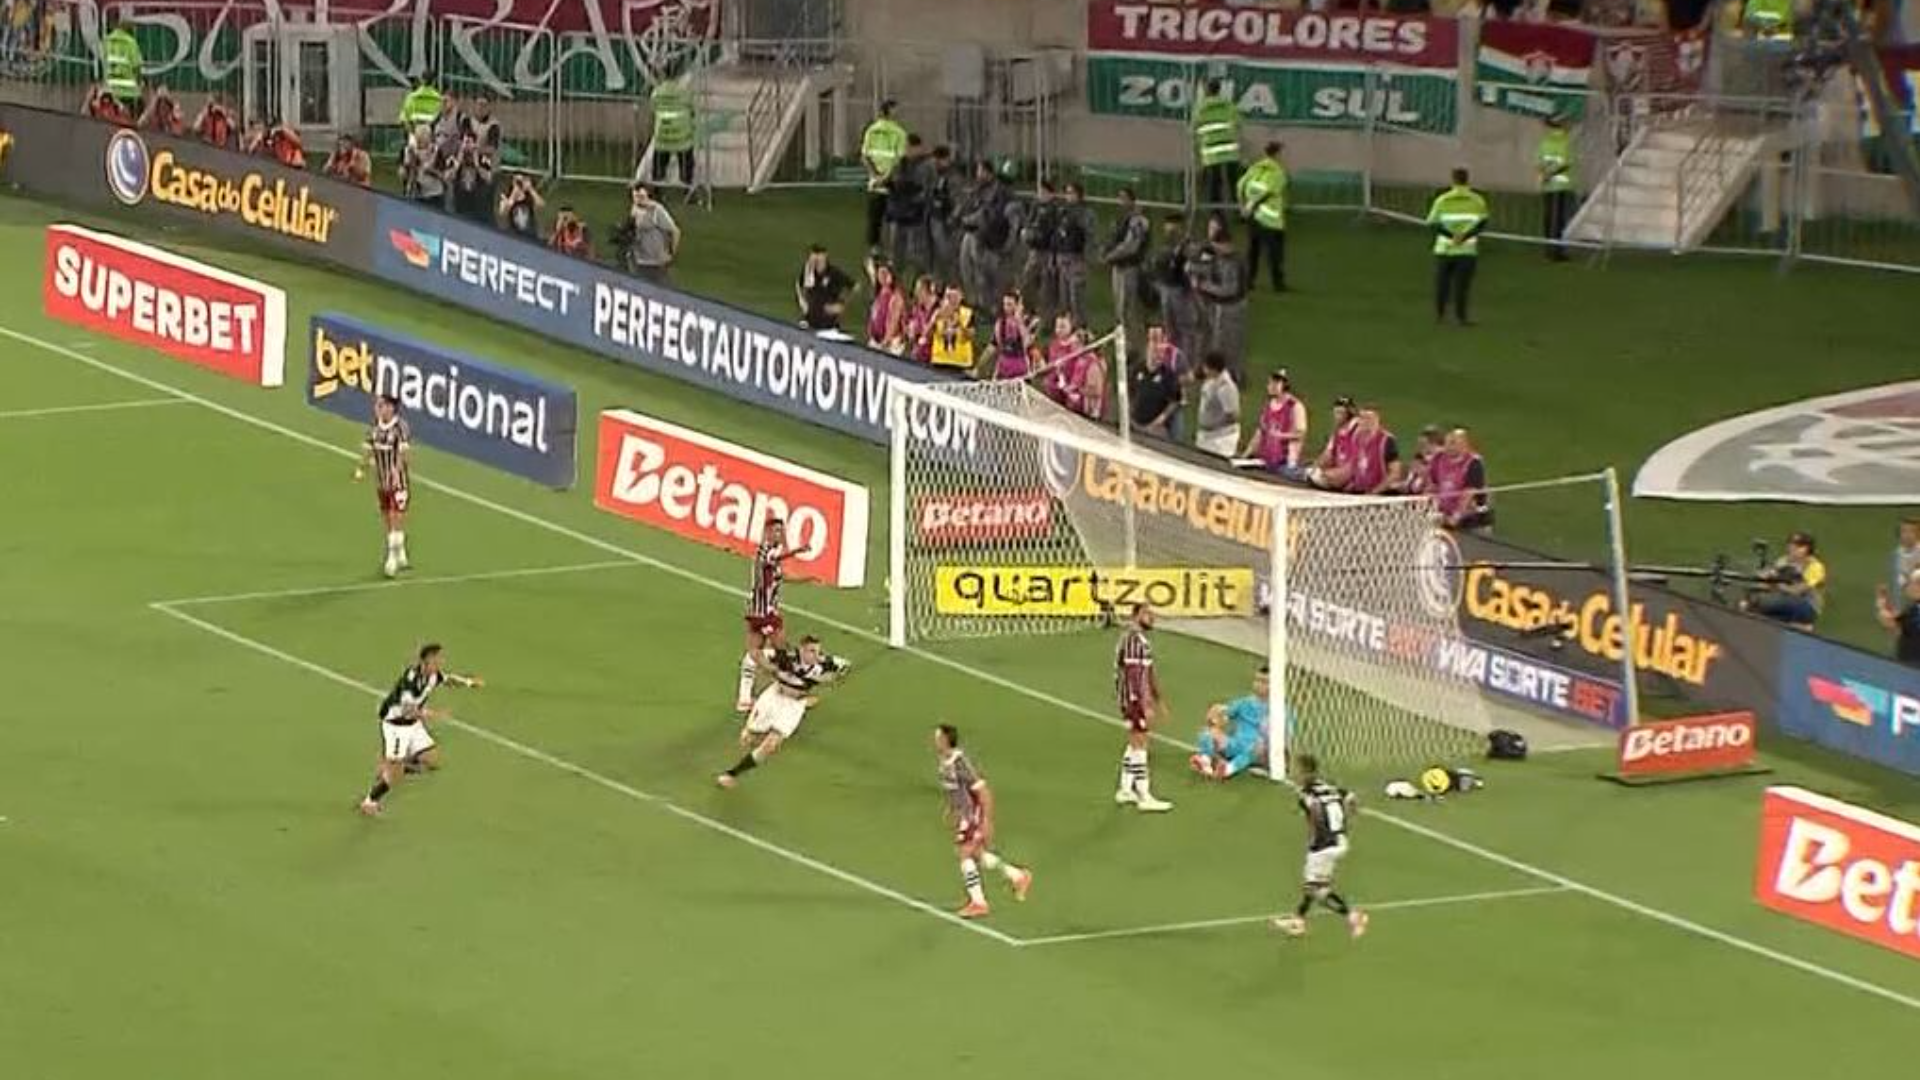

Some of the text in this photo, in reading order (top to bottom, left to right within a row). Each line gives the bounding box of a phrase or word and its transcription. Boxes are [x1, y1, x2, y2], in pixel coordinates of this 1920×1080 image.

[1115, 5, 1427, 54] TRICOLORES
[1312, 87, 1421, 124] SUL
[53, 244, 258, 354] SUPERBET
[440, 239, 977, 455] PERFECT PERFECTAUTOMOTIVCOM
[953, 569, 1238, 610] quartzolit
[1623, 723, 1750, 762] Betano
[1775, 815, 1920, 935] Bet
